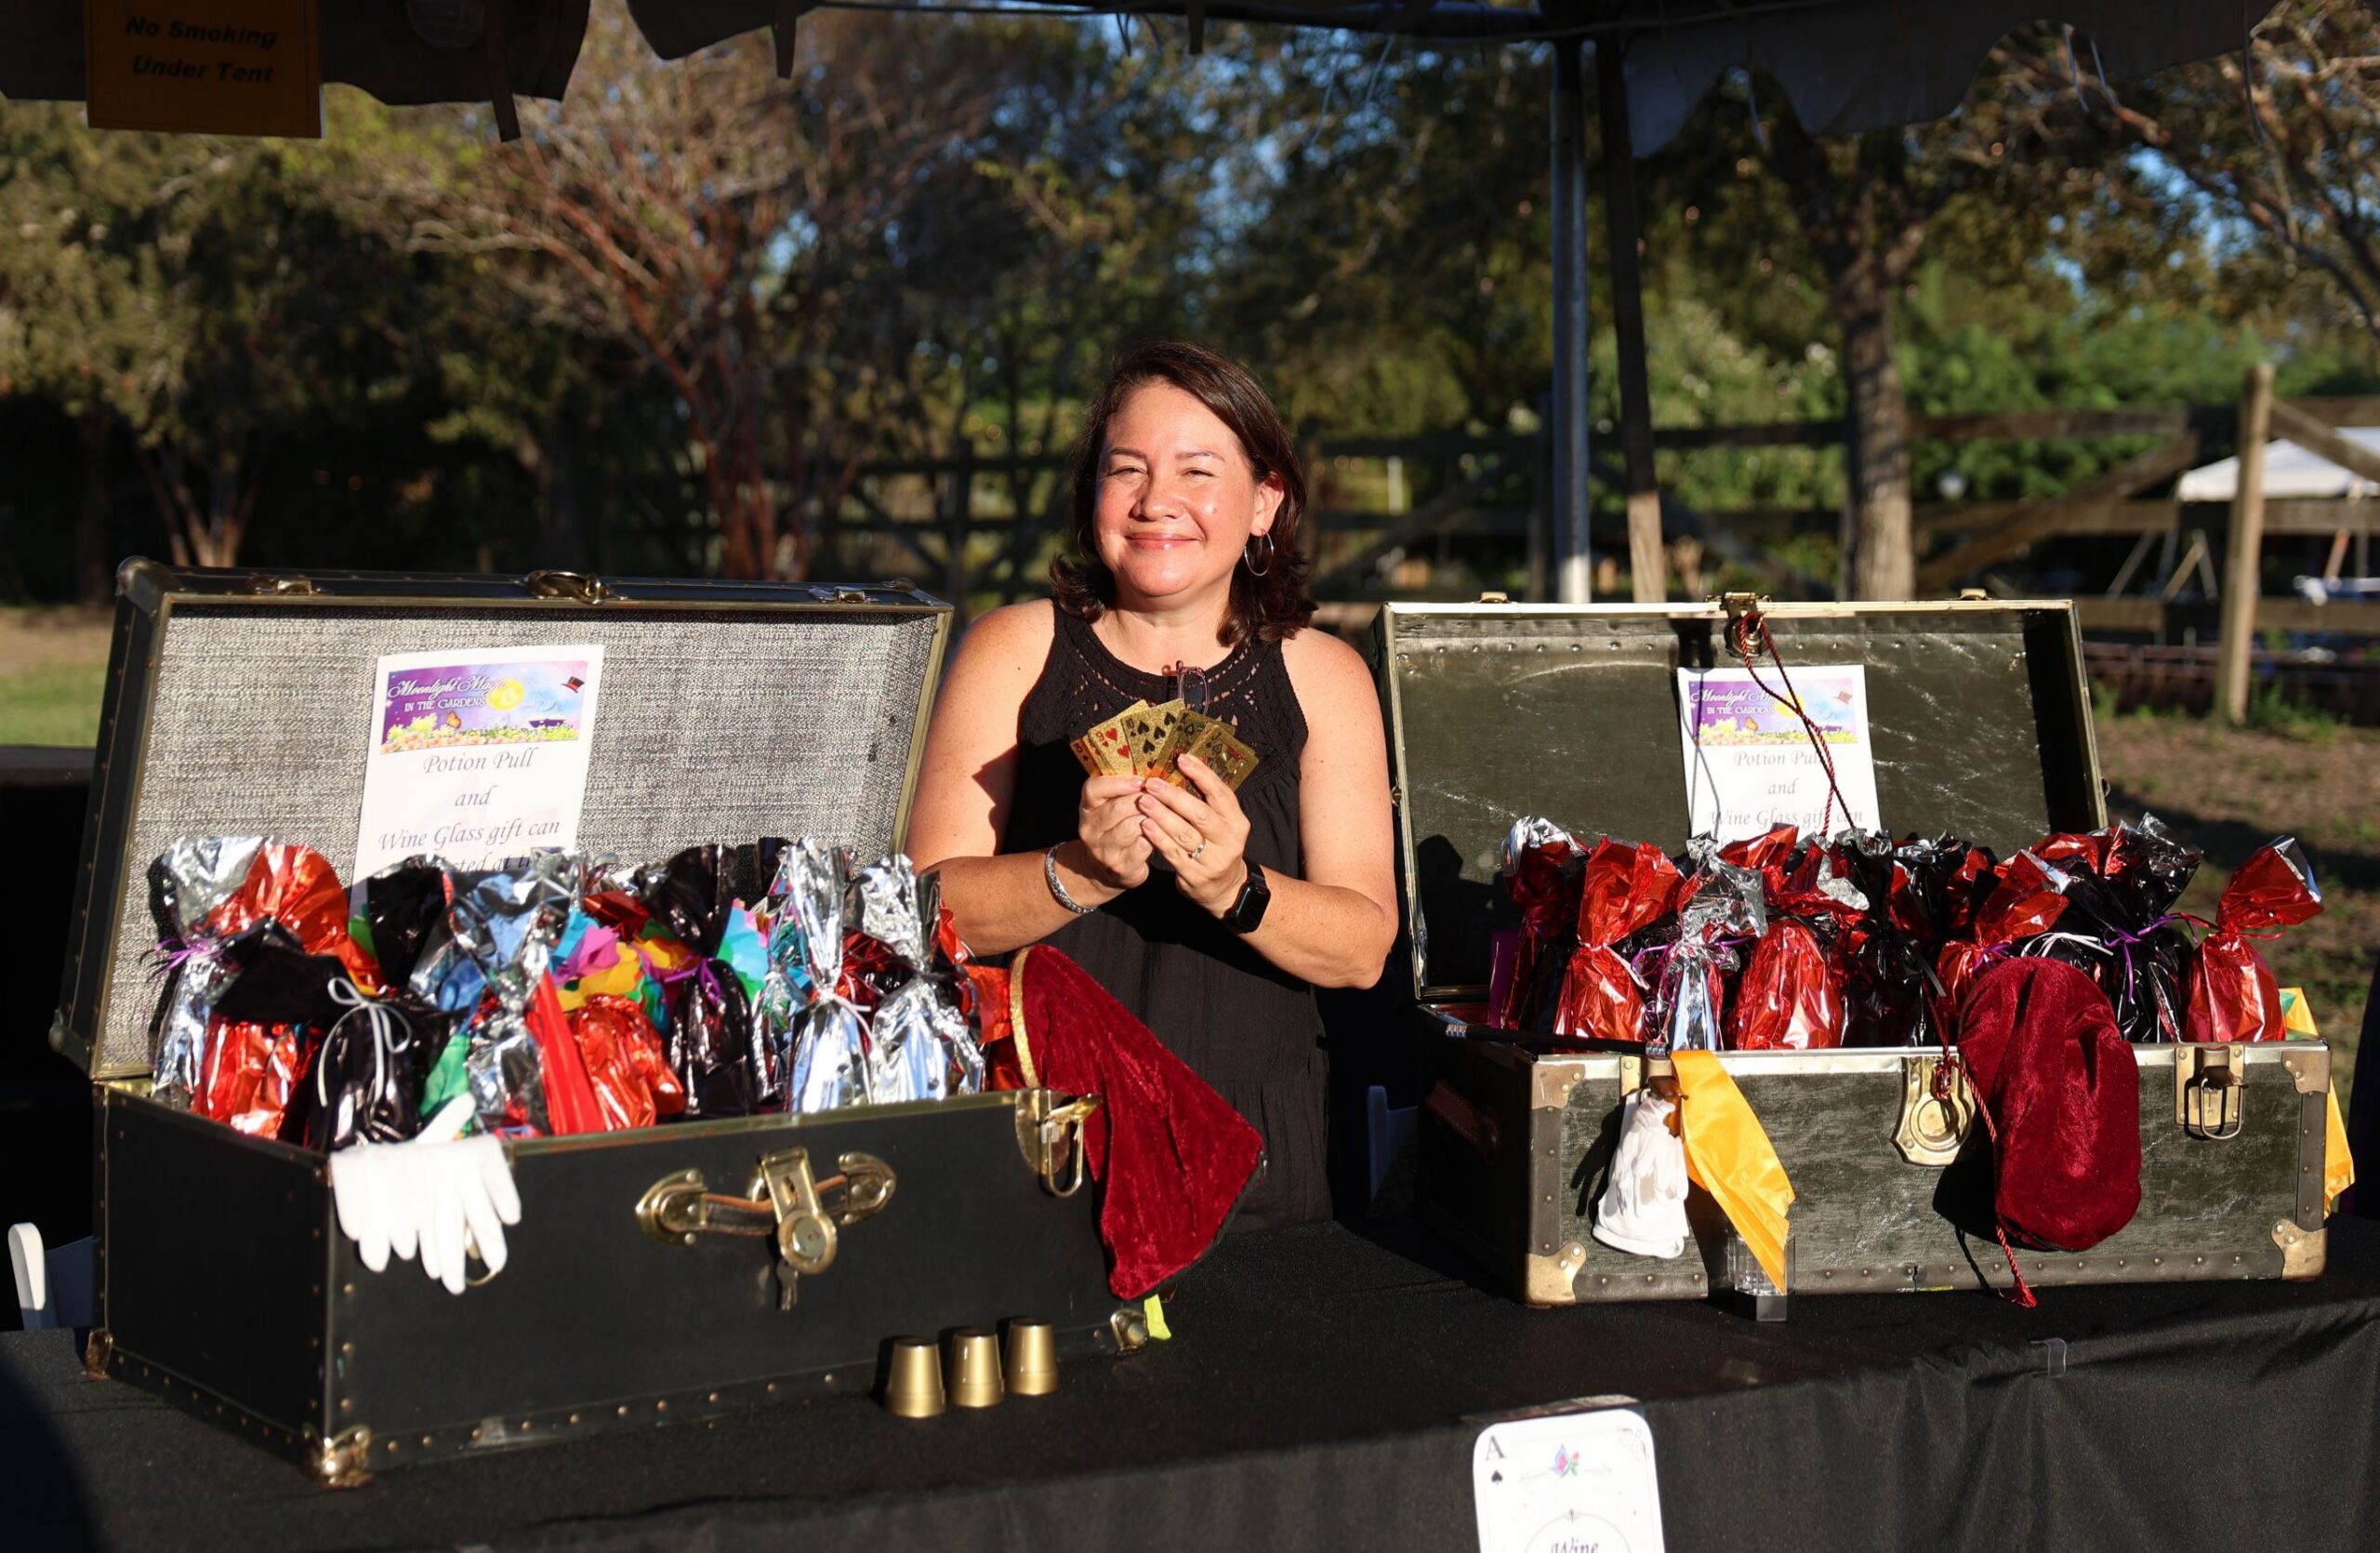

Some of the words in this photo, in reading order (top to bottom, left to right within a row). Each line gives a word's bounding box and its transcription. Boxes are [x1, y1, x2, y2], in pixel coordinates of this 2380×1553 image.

[124, 16, 159, 38] No
[166, 20, 277, 50] Smoking
[132, 55, 208, 80] Under
[217, 61, 274, 84] Tent
[387, 678, 459, 699] Moonlight
[1690, 689, 1749, 706] Moonlight
[404, 702, 415, 712] IN
[416, 700, 435, 710] THE
[437, 697, 486, 709] GARDENS
[1707, 706, 1715, 715] IN
[1717, 706, 1734, 715] THE
[1735, 706, 1775, 715] GARDENS
[423, 754, 486, 774] Potion
[493, 748, 538, 770] Pull
[1734, 750, 1785, 766] Potion
[1791, 750, 1824, 765] Pul
[455, 785, 496, 807] and
[1767, 777, 1799, 795] and
[1708, 809, 1751, 825] Wine
[1756, 807, 1798, 830] Glass
[1802, 807, 1827, 830] gif
[378, 829, 427, 851] Wine
[433, 822, 484, 851] Glass
[484, 818, 523, 846] gift
[528, 821, 561, 836] can
[1486, 1435, 1505, 1461] A
